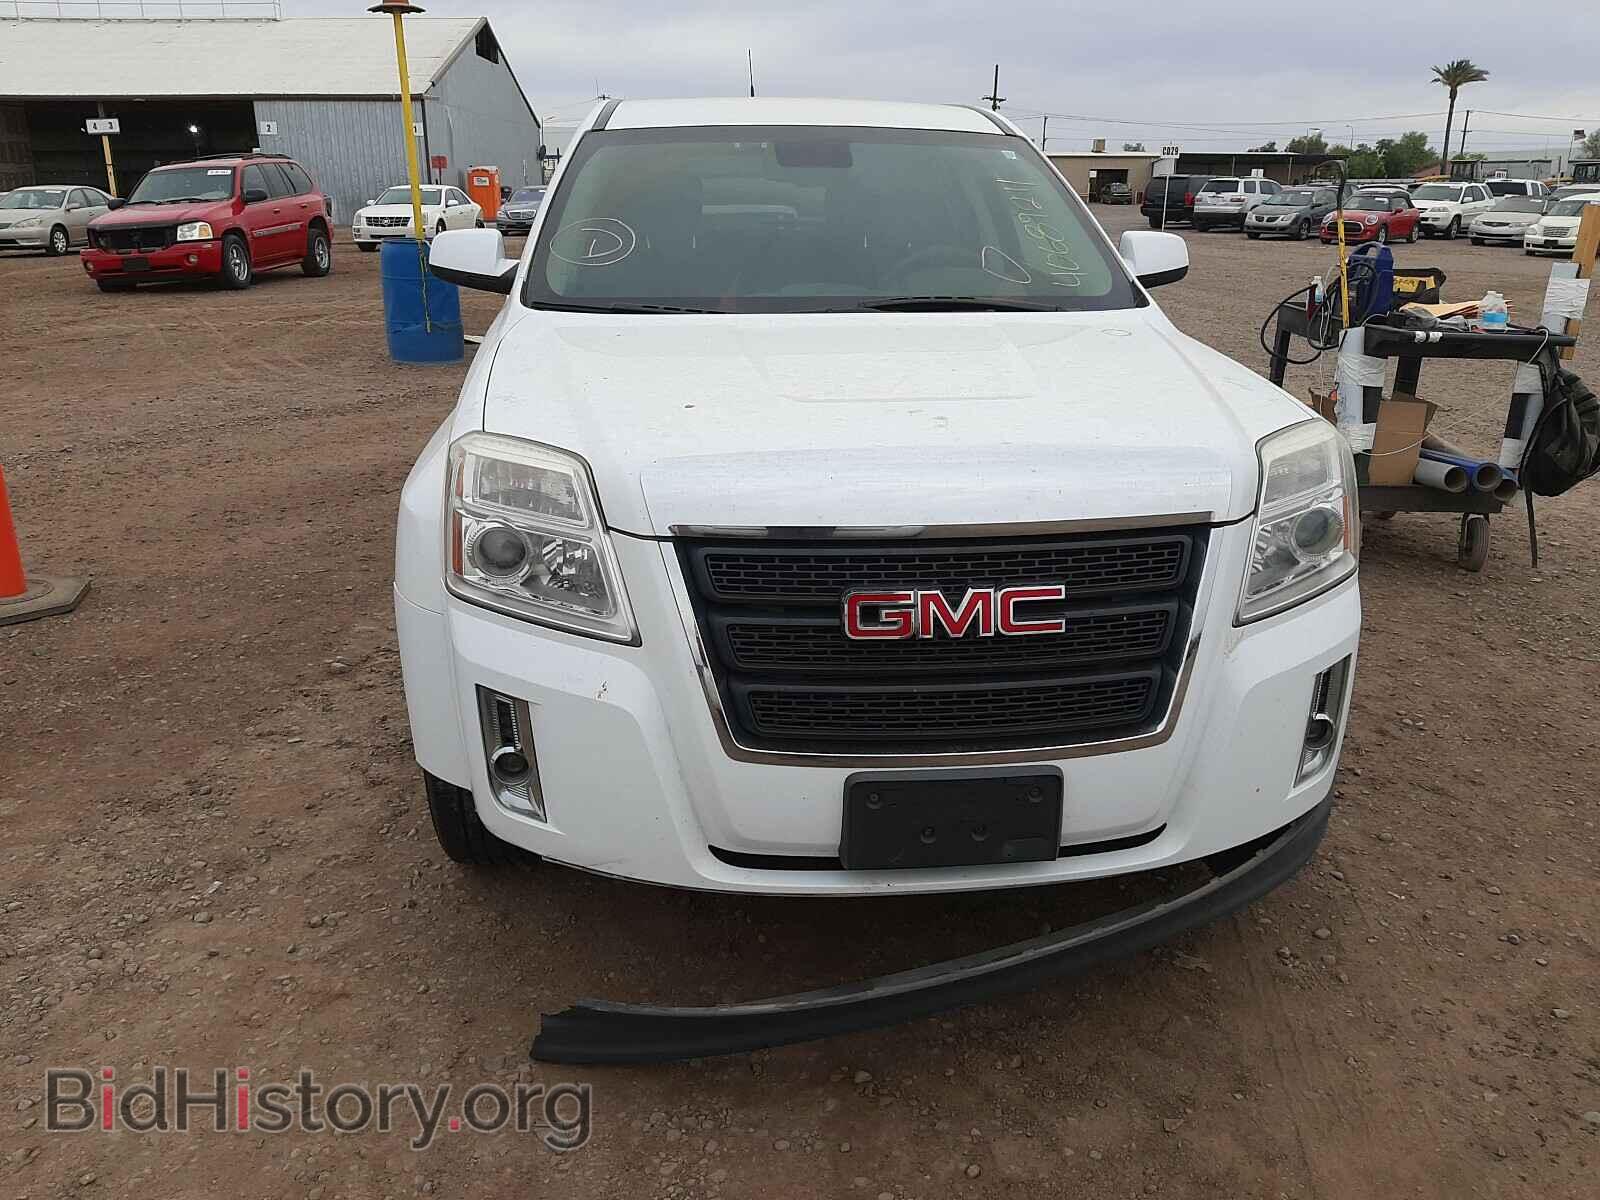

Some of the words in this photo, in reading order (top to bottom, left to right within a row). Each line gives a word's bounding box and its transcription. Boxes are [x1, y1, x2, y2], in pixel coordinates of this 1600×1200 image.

[93, 121, 98, 131] 4
[108, 121, 114, 130] 3
[844, 584, 1066, 640] GMC
